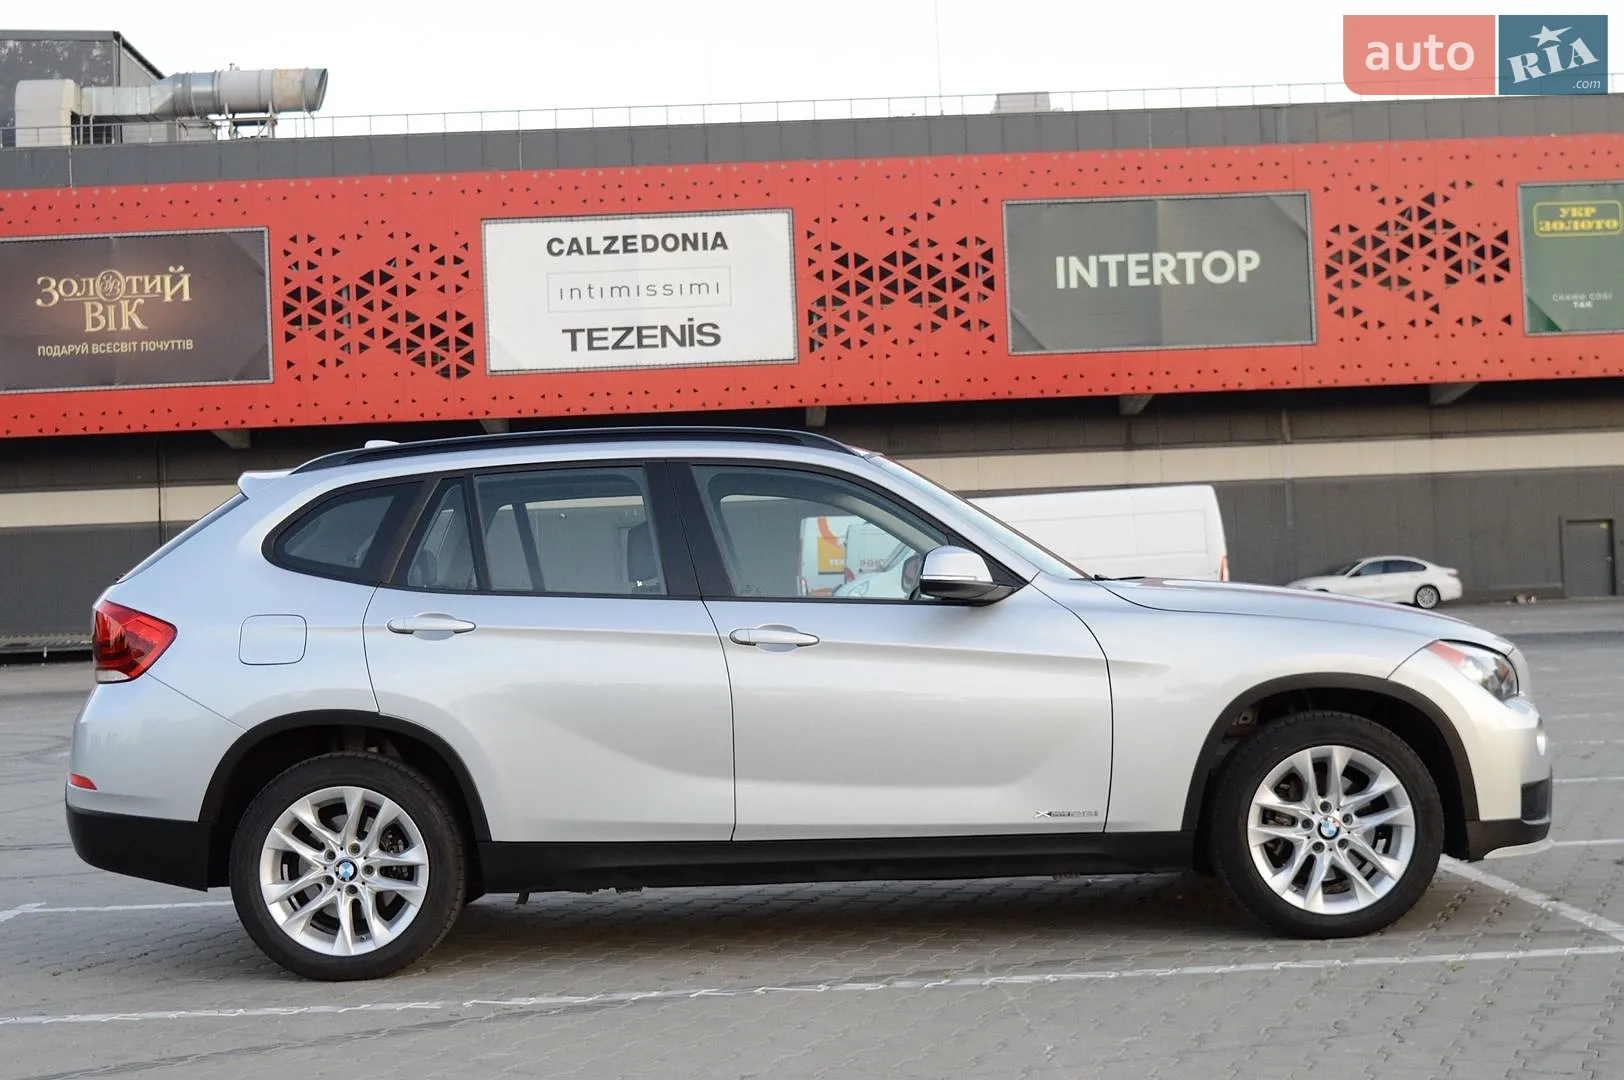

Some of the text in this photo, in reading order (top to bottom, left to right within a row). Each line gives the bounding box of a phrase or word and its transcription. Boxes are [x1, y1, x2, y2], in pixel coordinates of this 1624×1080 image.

[1559, 206, 1597, 218] УКР
[1538, 219, 1619, 232] ЗОЛОТО
[546, 232, 729, 257] CALZEDONIA
[1055, 250, 1261, 289] INTERTOP
[35, 265, 193, 307] ЗОЛОТИЙ
[559, 281, 720, 301] intimissimi
[84, 298, 148, 332] ВІК
[37, 339, 194, 358] ПОДАРУЙ ВСЕСВІТ ПОЧУТТІВ
